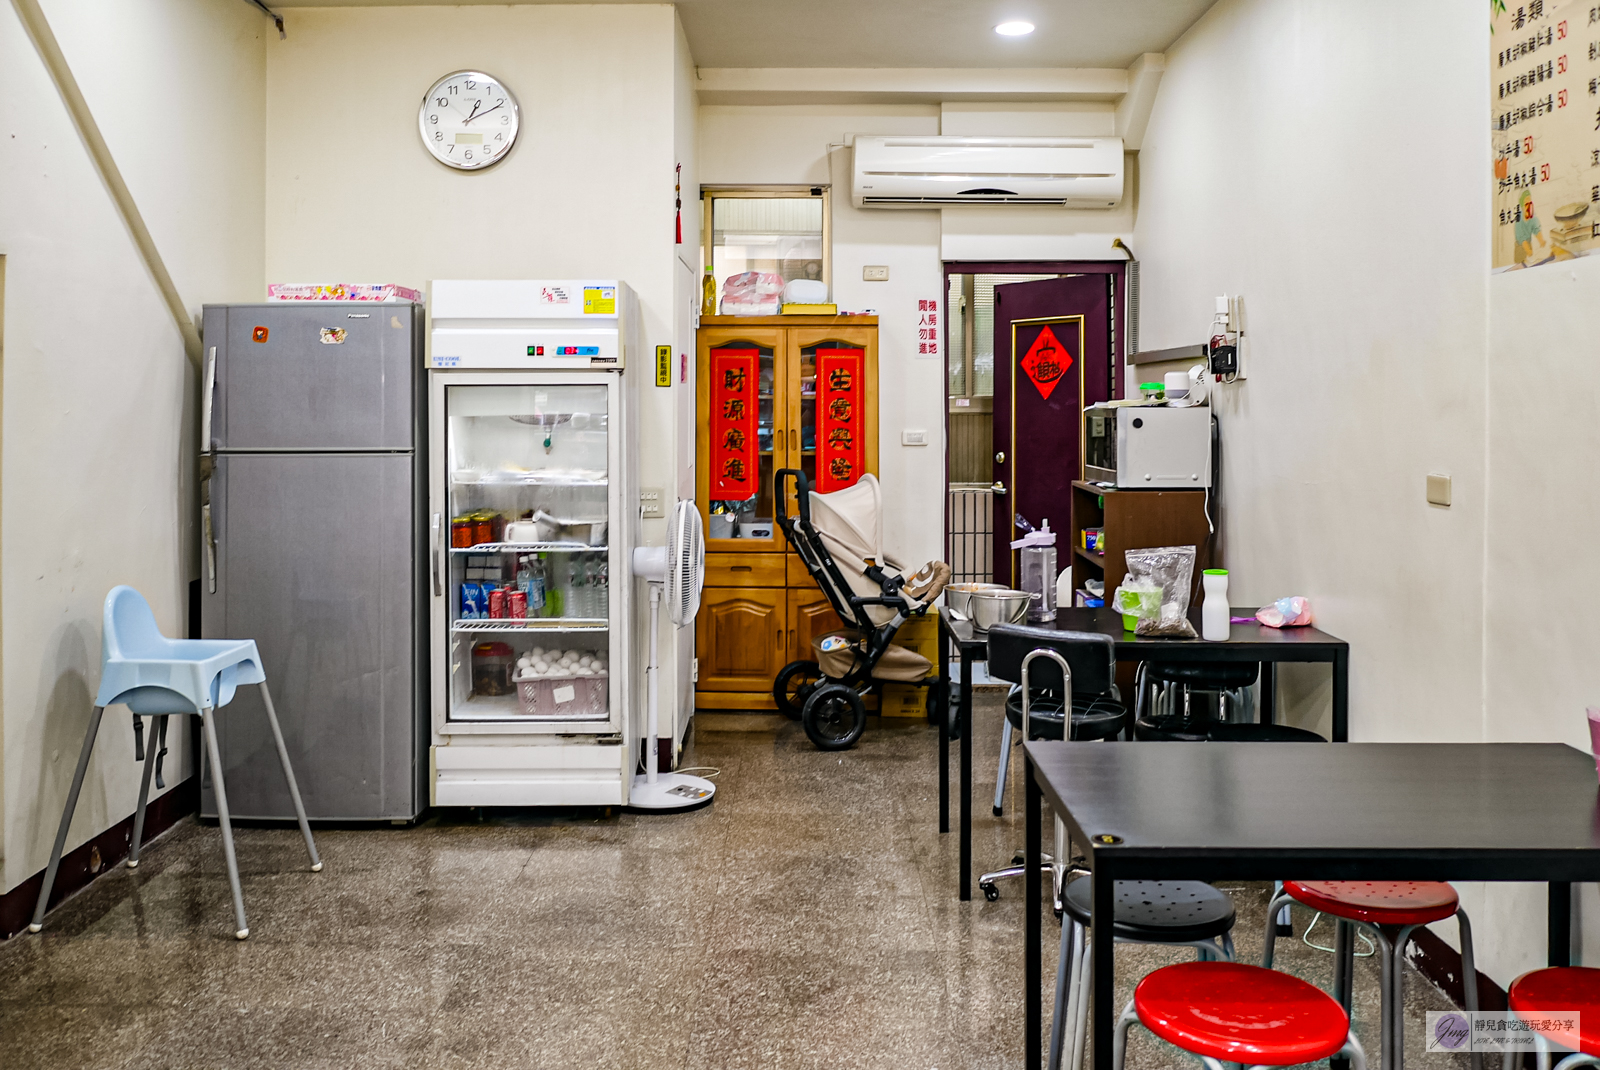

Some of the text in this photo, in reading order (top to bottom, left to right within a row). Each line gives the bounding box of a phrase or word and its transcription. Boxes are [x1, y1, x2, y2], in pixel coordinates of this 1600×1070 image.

[1511, 0, 1543, 31] 湯類
[1557, 20, 1568, 41] 50
[1557, 54, 1568, 74] 50
[447, 86, 458, 95] 11
[464, 81, 476, 90] 12
[486, 86, 491, 95] 1
[436, 97, 448, 107] 10
[496, 98, 504, 108] 2
[1557, 88, 1568, 108] 50
[430, 114, 438, 124] 9
[501, 116, 509, 125] 3
[435, 132, 443, 141] 8
[494, 133, 503, 142] 4
[447, 144, 455, 154] 7
[483, 145, 491, 154] 5
[1523, 135, 1533, 155] 50
[464, 150, 473, 159] 6
[1540, 163, 1550, 182] 50
[928, 300, 938, 354] 機房重地
[722, 366, 747, 483] 財源廣進
[828, 367, 853, 482] 生意興隆
